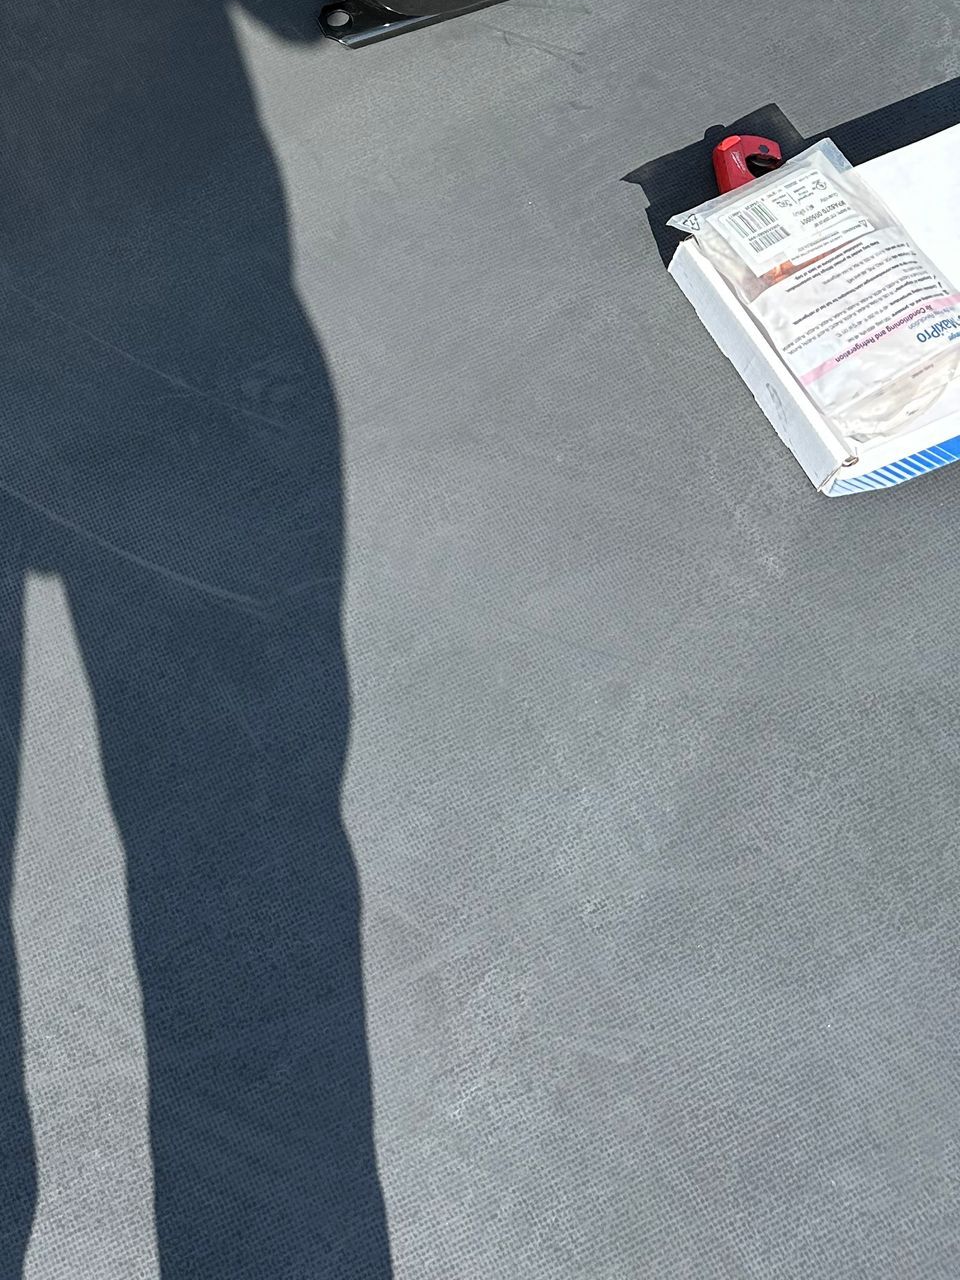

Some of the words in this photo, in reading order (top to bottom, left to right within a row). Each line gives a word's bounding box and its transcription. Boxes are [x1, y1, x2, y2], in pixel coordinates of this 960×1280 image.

[885, 306, 926, 332] Conditioning
[874, 328, 886, 340] and
[834, 336, 875, 363] Refrigeration
